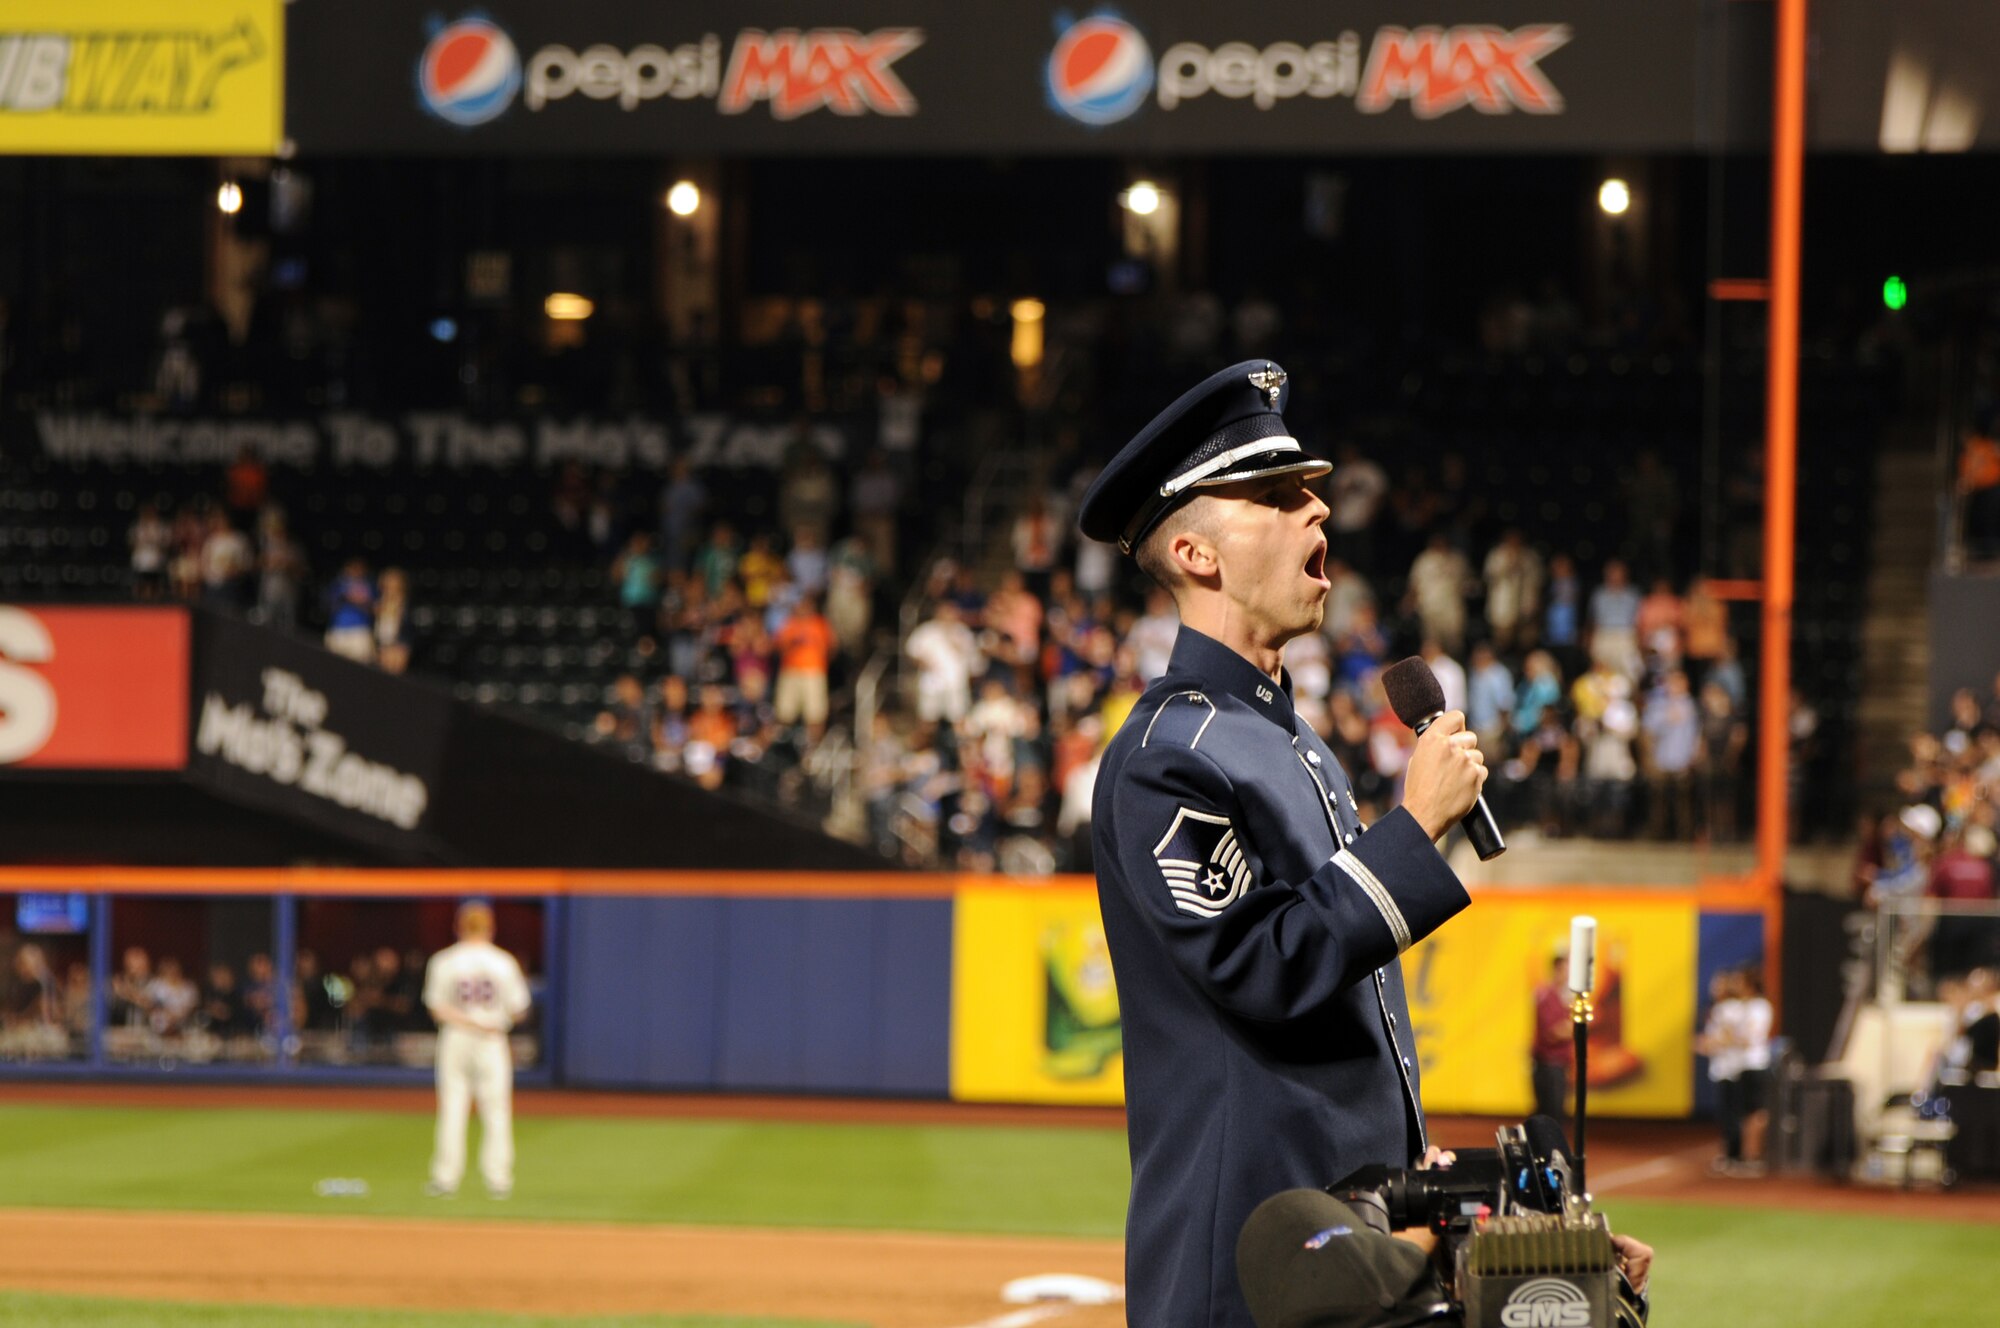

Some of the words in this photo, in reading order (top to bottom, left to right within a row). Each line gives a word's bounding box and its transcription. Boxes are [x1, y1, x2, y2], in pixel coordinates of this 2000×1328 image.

[525, 33, 721, 112] pepsi
[718, 27, 926, 121] MAX
[1158, 30, 1361, 111] pepsi
[1356, 23, 1573, 120] MAX
[36, 413, 316, 466] Welcome
[326, 412, 396, 465] To
[404, 413, 524, 467] The
[261, 666, 328, 731] The
[197, 692, 301, 785] Mo's
[300, 729, 428, 830] Zone
[1500, 1300, 1591, 1328] GMS
